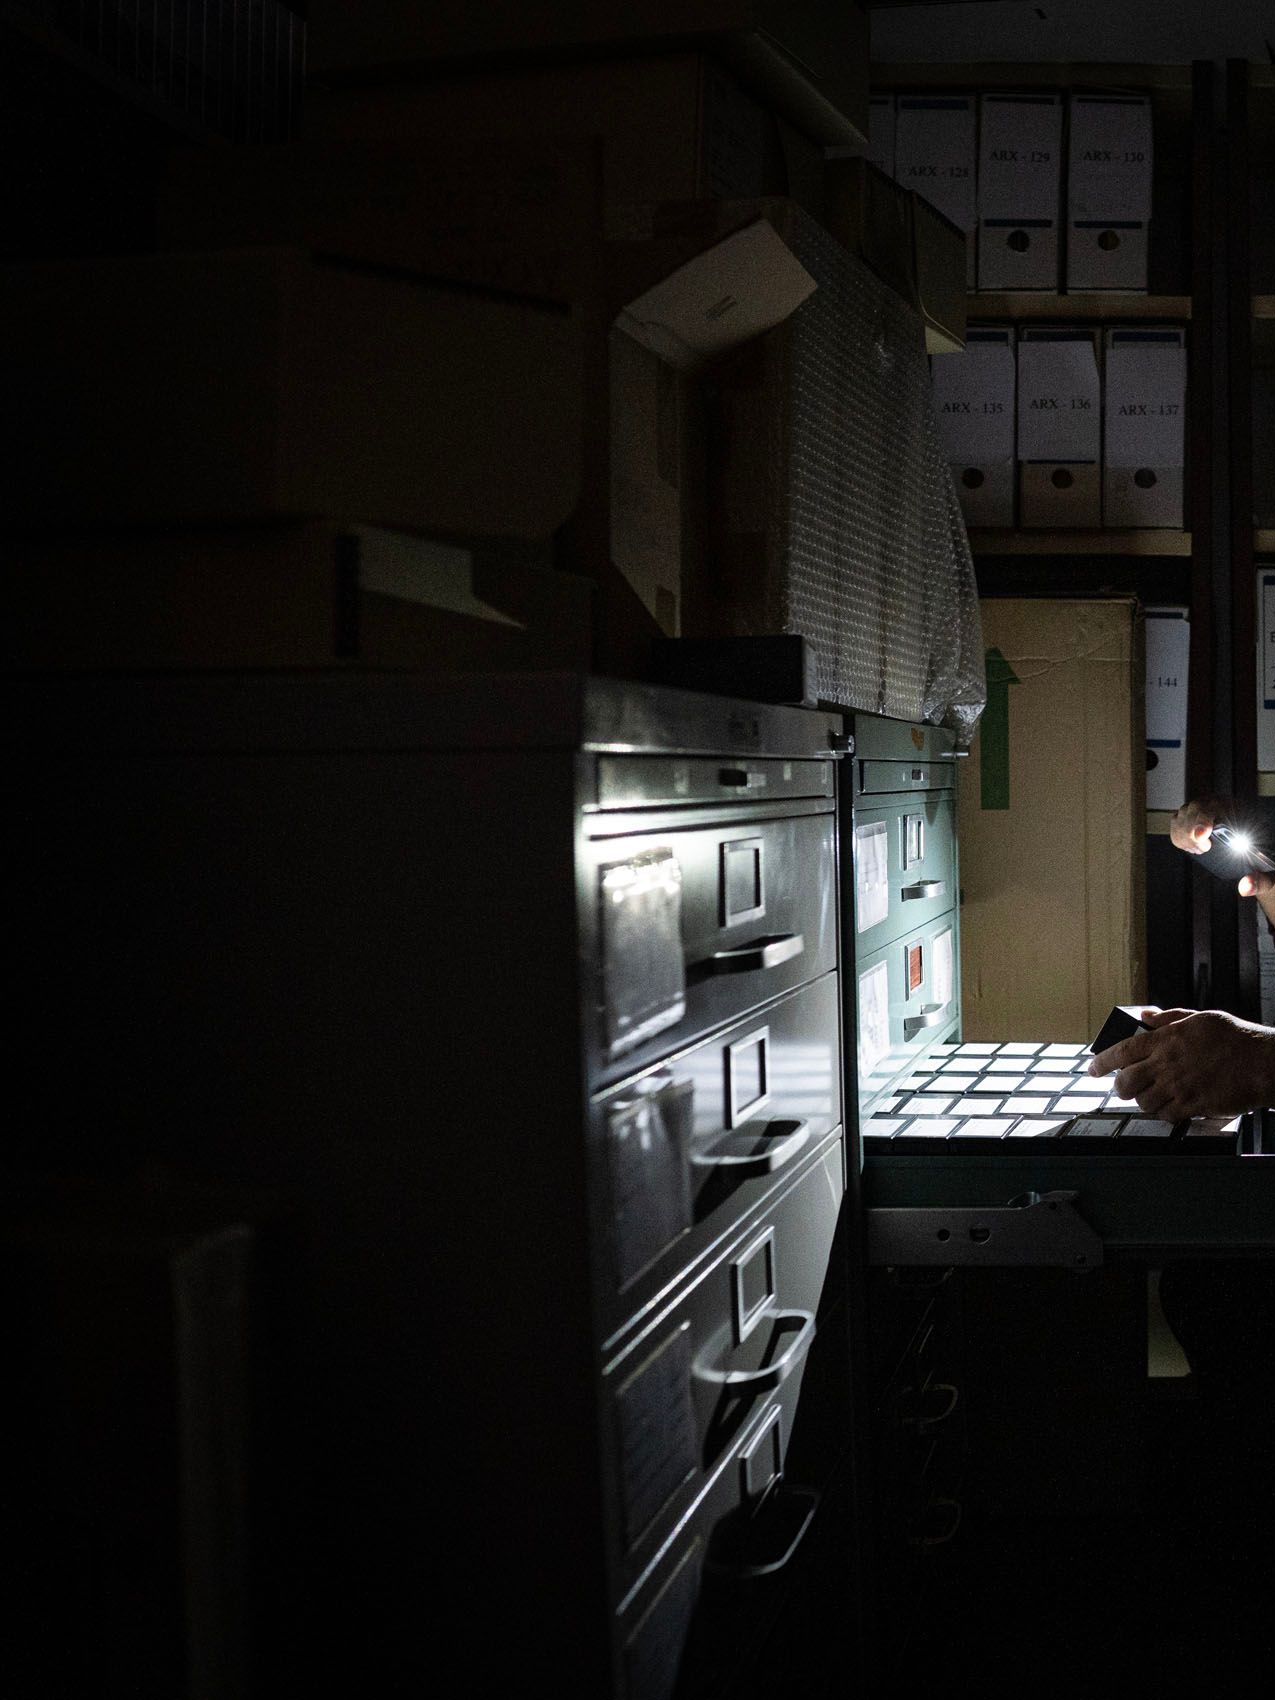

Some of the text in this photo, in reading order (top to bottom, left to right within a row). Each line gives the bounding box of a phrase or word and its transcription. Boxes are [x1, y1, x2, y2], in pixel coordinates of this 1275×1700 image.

[989, 150, 1018, 162] ARX
[1031, 151, 1051, 163] 129
[1083, 151, 1111, 162] ARX
[1125, 152, 1145, 163] 130
[908, 166, 937, 177] ARX
[942, 402, 971, 413] ARX
[983, 403, 1003, 414] 135
[1030, 398, 1058, 410] ARX
[1071, 398, 1091, 410] 136
[1118, 404, 1147, 416] ARX
[1159, 404, 1180, 416] 137
[1158, 677, 1177, 689] 144
